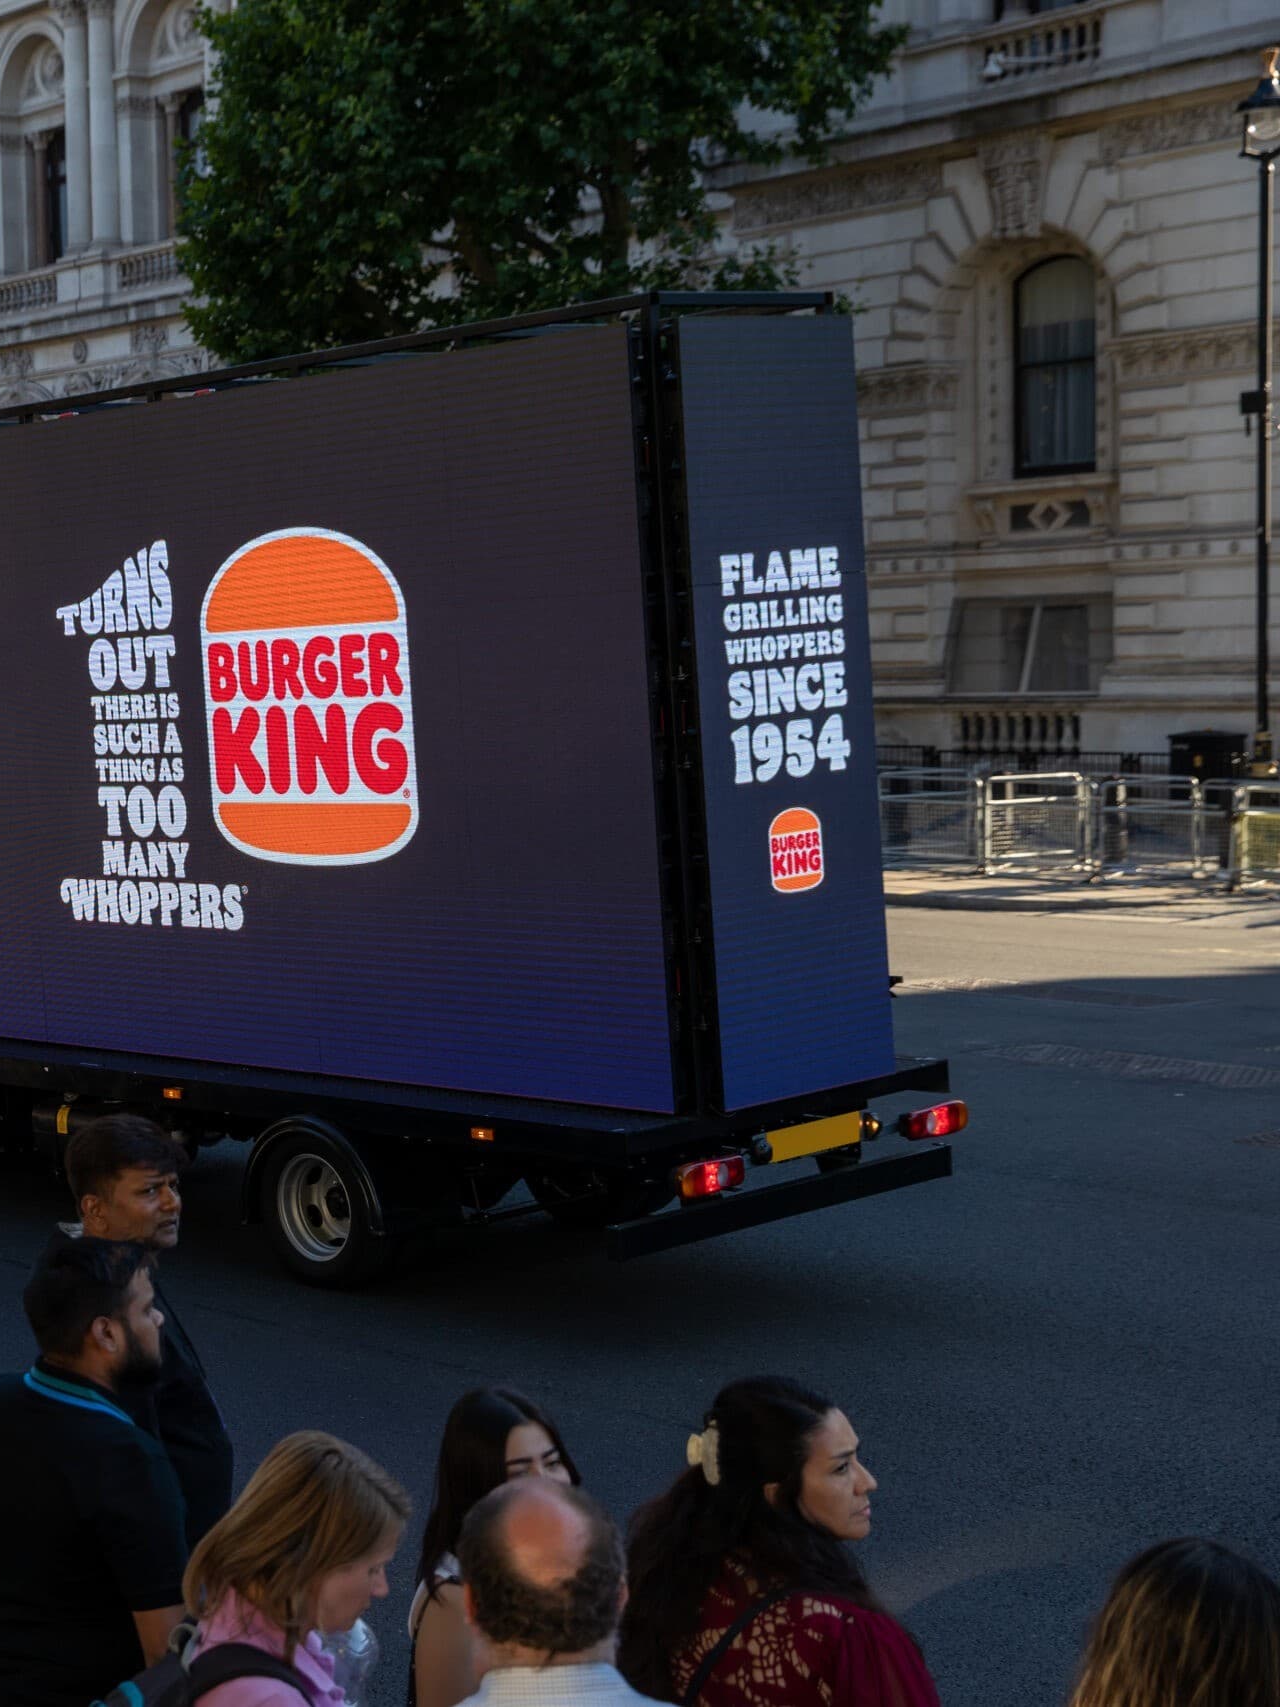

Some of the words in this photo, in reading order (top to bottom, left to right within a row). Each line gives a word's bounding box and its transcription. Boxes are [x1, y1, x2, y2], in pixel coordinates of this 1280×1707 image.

[56, 539, 173, 636] TURNS
[720, 546, 841, 596] FLAME
[723, 594, 844, 632] GRILLING
[88, 634, 176, 691] OUT
[208, 632, 404, 702] BURGER
[725, 629, 845, 665] WHOPPERS
[90, 693, 157, 720] THERE
[159, 692, 180, 719] IS
[728, 661, 848, 719] SINCE
[93, 723, 160, 755] SUCH
[163, 722, 183, 754] A
[212, 702, 408, 795] KING
[730, 714, 851, 784] 1954
[95, 758, 156, 783] THING
[158, 757, 185, 782] AS
[97, 785, 187, 838] TOO
[101, 840, 190, 878] MANY
[771, 831, 820, 854] BURGER
[772, 849, 821, 877] KING
[59, 878, 245, 931] WHOPPERS
